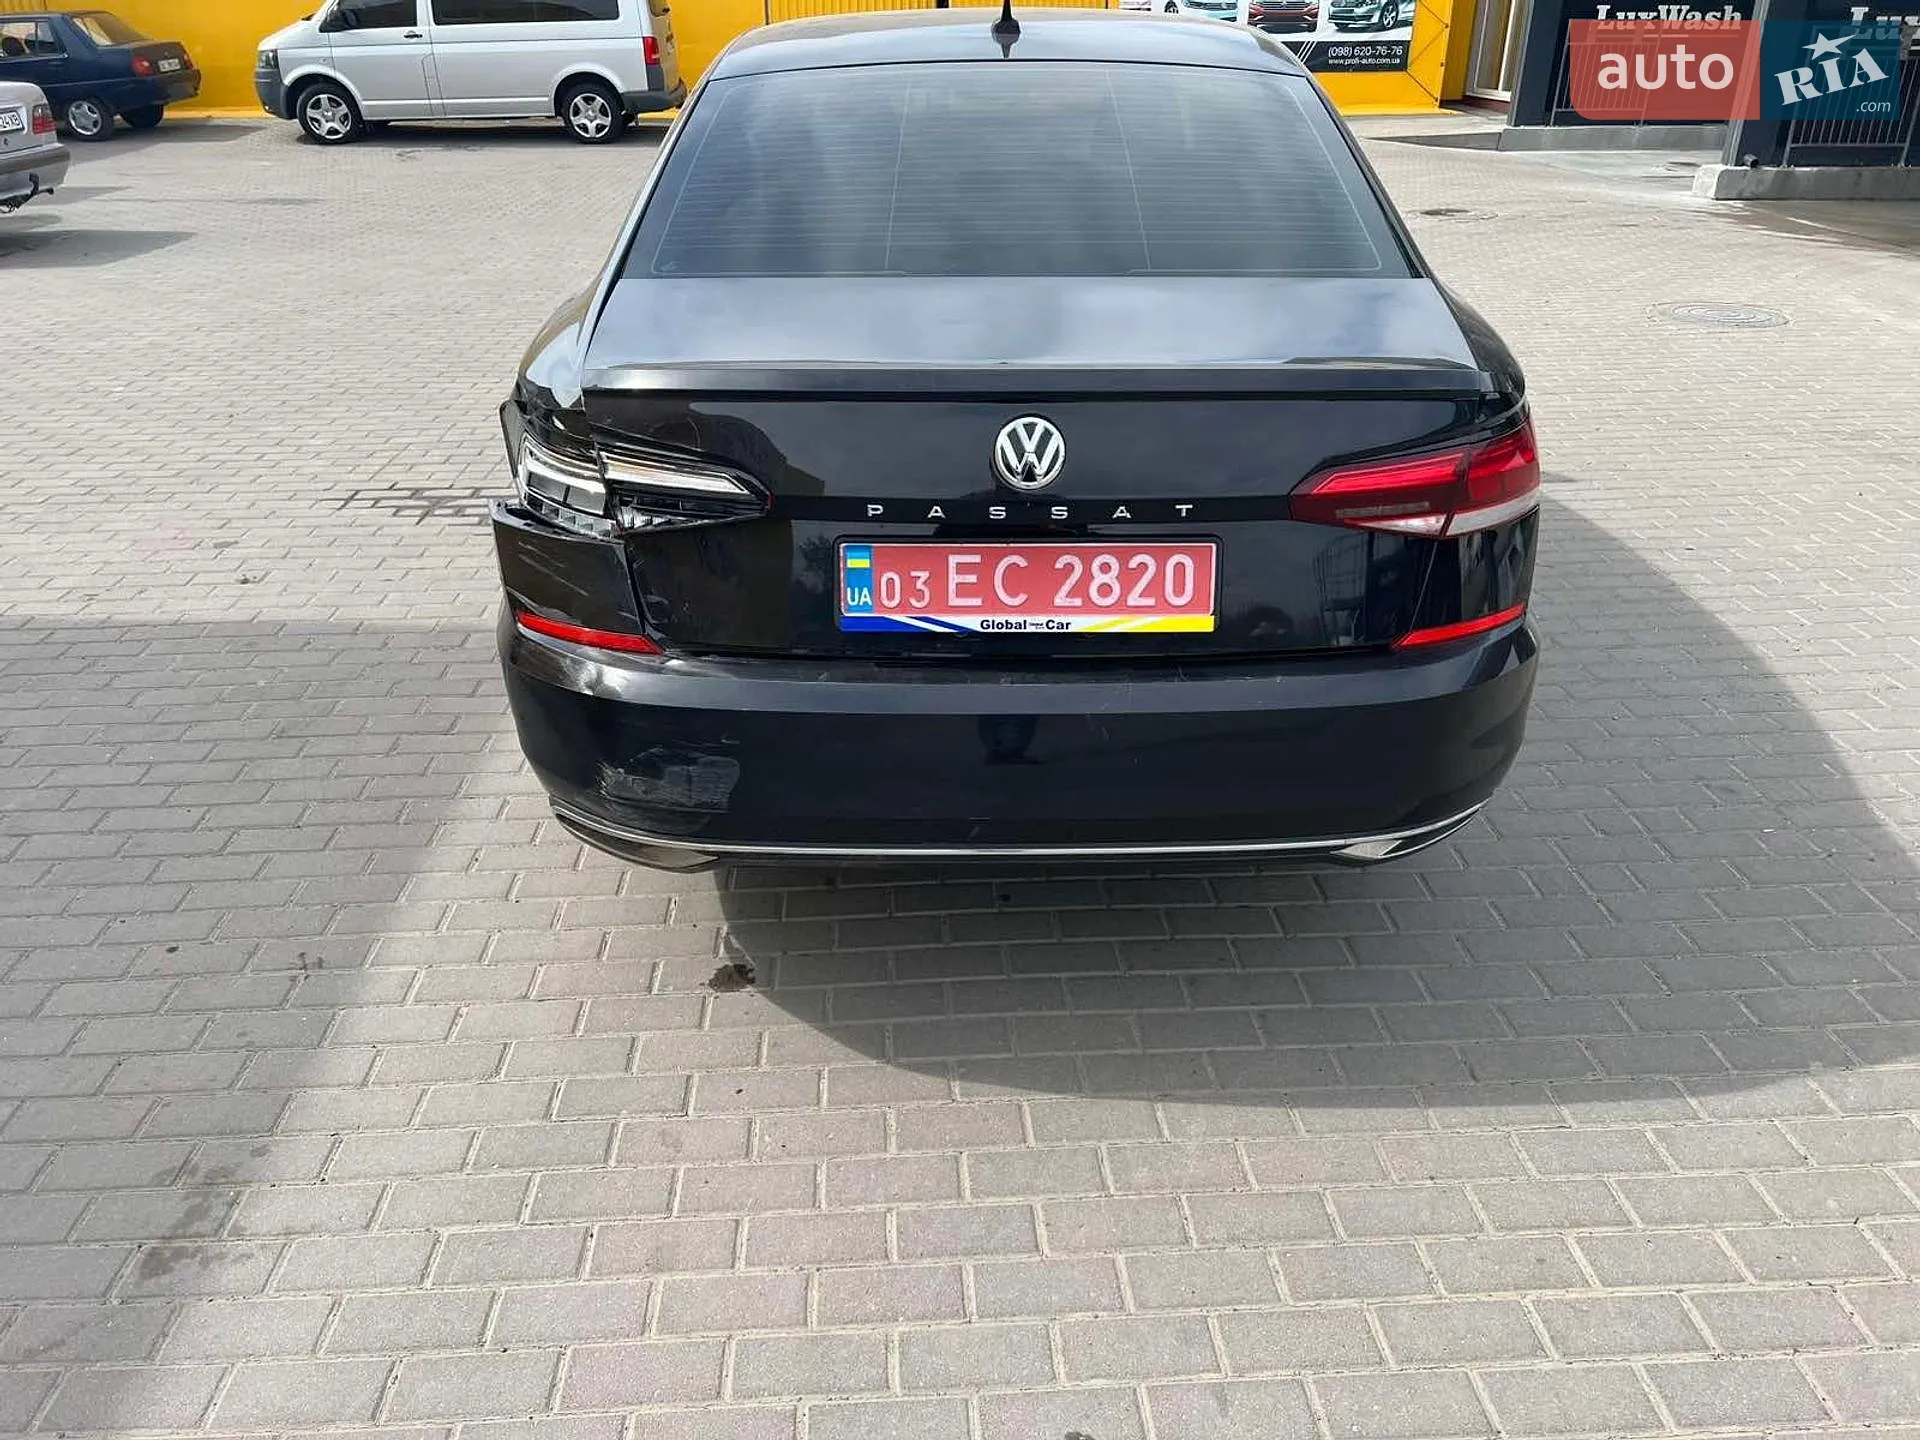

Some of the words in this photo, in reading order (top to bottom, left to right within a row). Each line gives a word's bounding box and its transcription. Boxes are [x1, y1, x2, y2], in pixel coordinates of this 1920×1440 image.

[1596, 4, 1742, 31] LuxWash
[1328, 46, 1353, 58] (098)
[1354, 45, 1403, 57] 620-76-76
[866, 503, 1194, 520] PASSAT
[847, 587, 872, 606] UA
[880, 570, 932, 609] 03
[947, 554, 1029, 607] EC
[1053, 553, 1195, 607] 2820
[980, 619, 1027, 630] Global
[1045, 619, 1072, 630] Car
